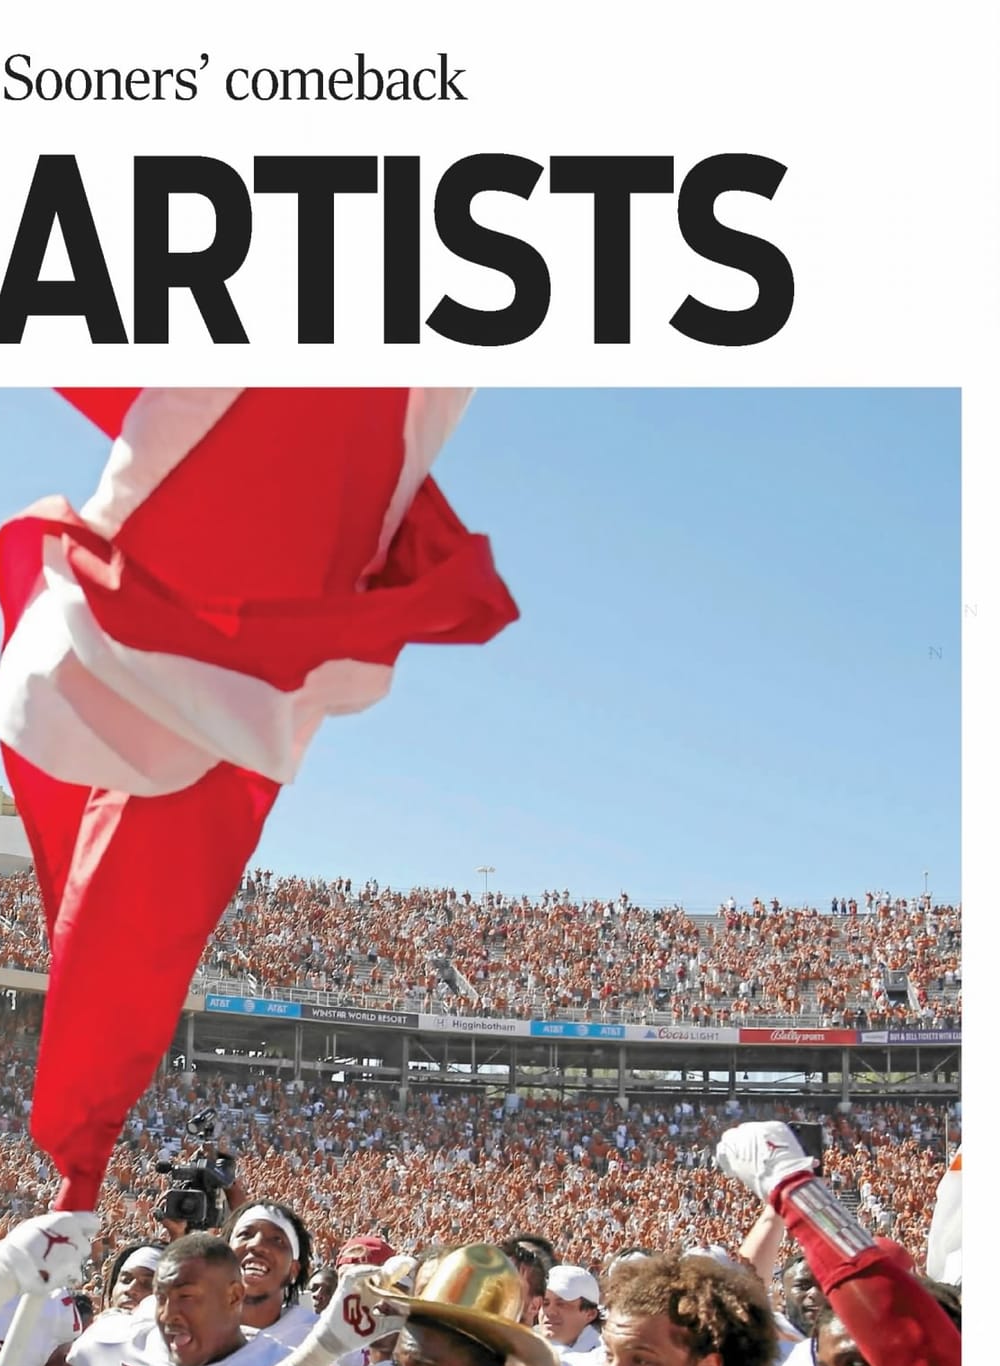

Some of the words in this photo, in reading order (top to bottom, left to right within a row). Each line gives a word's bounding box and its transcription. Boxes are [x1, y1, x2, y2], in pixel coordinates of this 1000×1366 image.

[3, 52, 209, 101] Sooners’
[225, 52, 469, 101] comeback
[209, 999, 231, 1008] AT&T
[266, 1003, 289, 1014] AT&T
[311, 1008, 347, 1020] WINSTAR
[348, 1011, 377, 1022] WORLD
[377, 1013, 409, 1025] RESORT
[451, 1019, 516, 1032] Higginbotham
[690, 1032, 720, 1041] LIGHT
